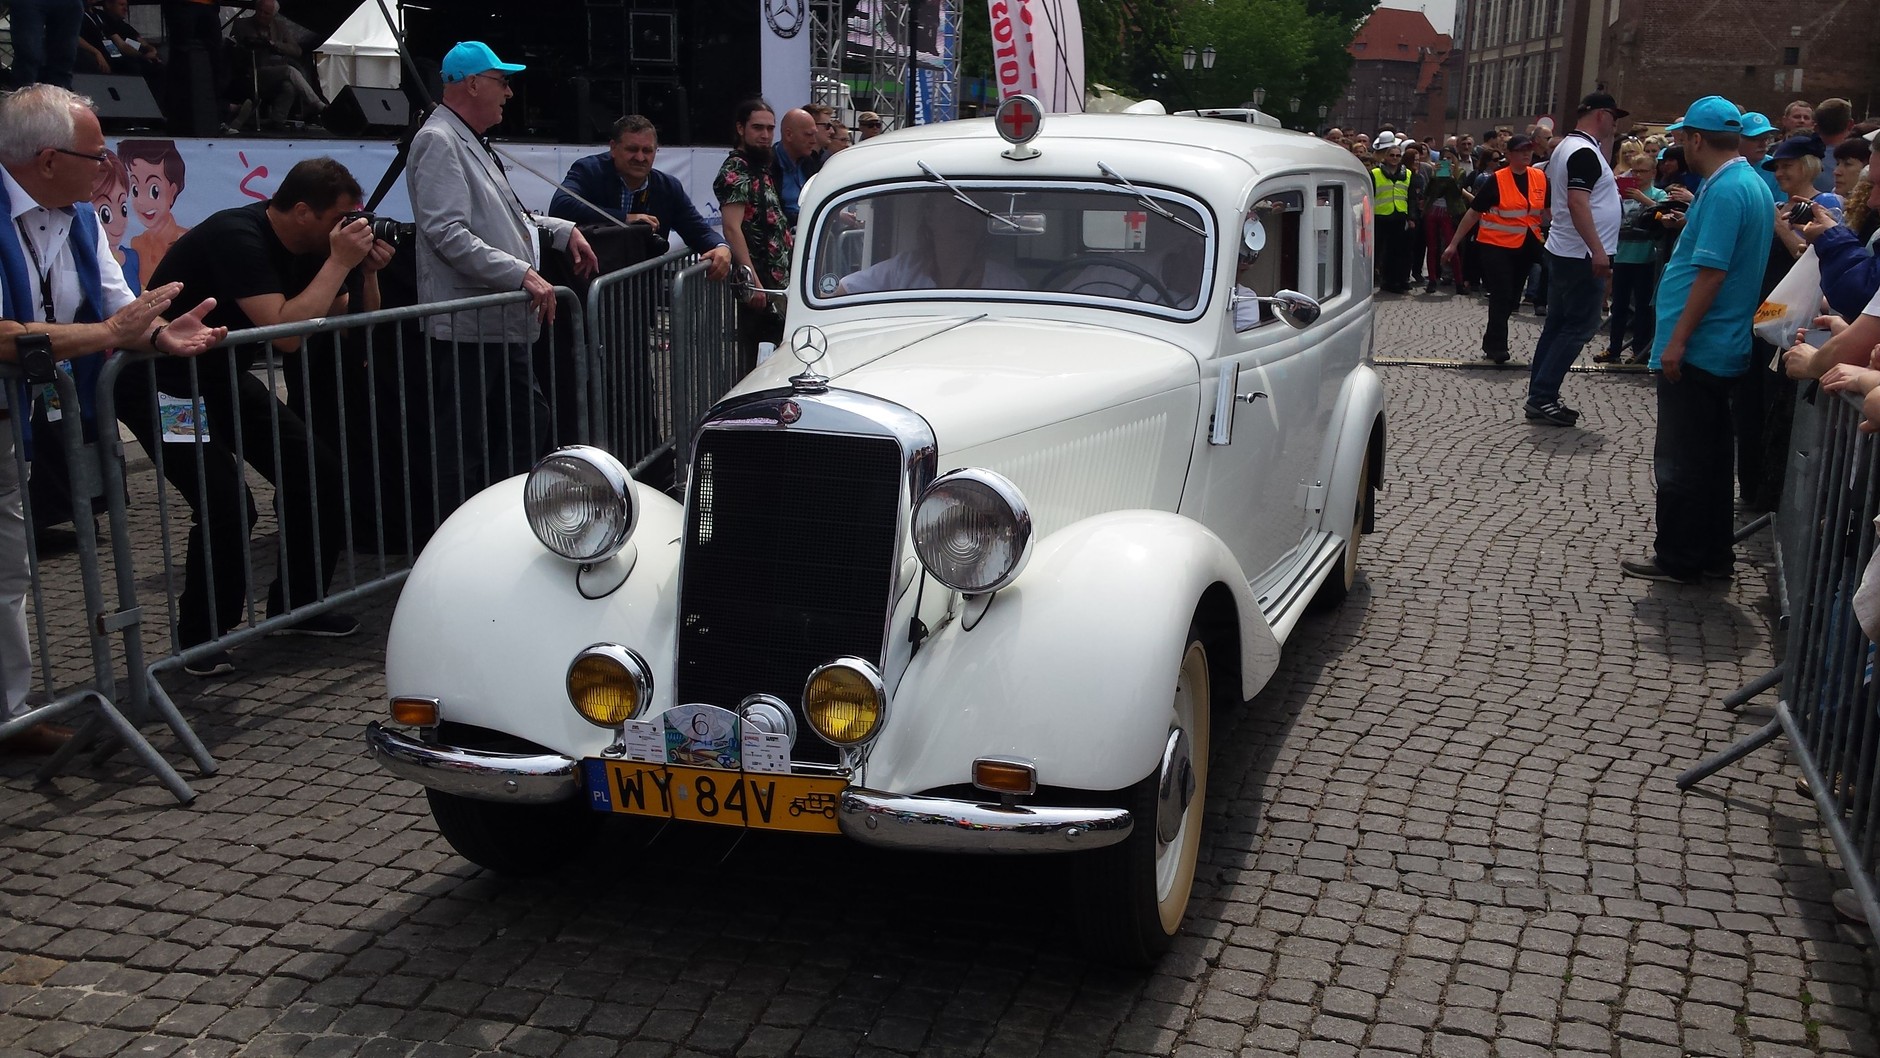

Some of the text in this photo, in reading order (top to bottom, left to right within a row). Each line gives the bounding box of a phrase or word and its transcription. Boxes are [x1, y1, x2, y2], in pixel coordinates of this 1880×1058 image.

[691, 712, 709, 736] 6
[593, 790, 609, 803] PL
[614, 767, 776, 823] WY 84V
